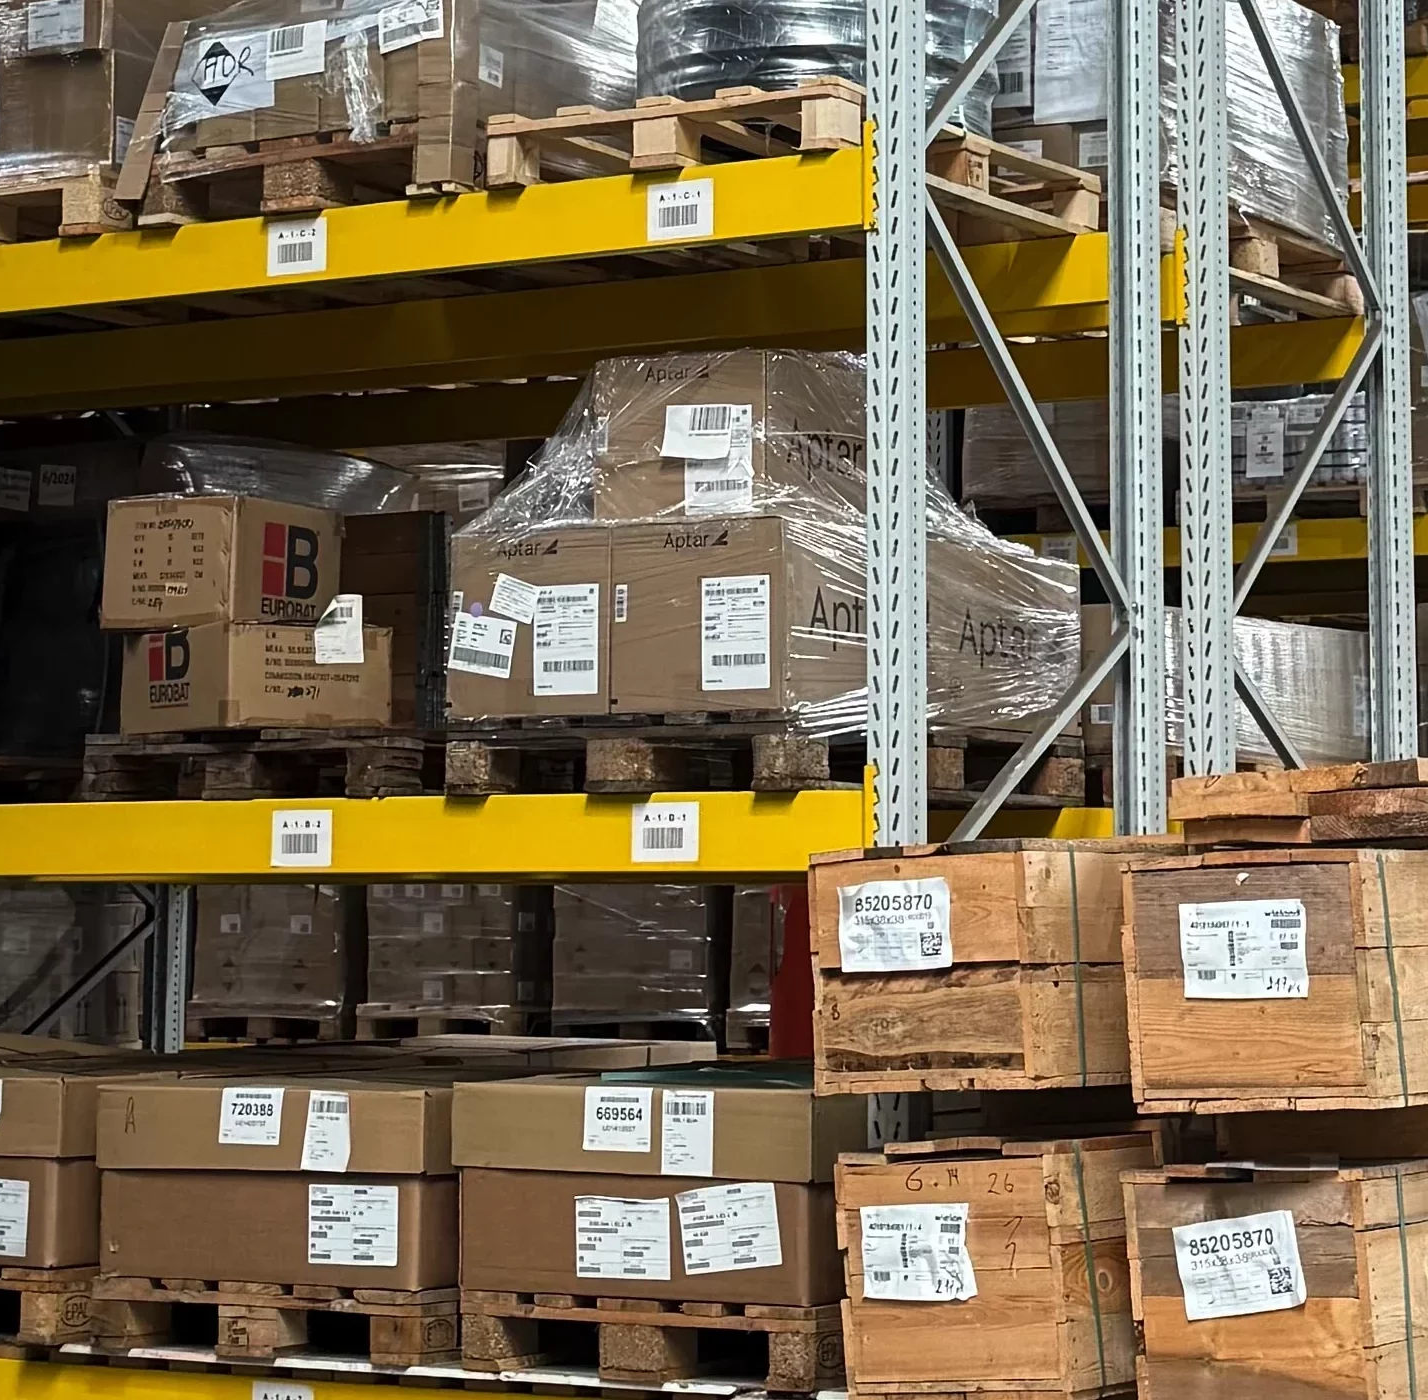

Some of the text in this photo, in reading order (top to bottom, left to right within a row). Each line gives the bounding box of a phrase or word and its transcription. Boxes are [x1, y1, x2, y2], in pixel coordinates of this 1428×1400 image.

[663, 531, 709, 551] Aptar
[261, 597, 316, 617] EUROBAT
[810, 586, 866, 650] Apt
[149, 682, 190, 703] EUROBAT
[231, 1103, 274, 1117] 720388
[596, 1106, 643, 1121] 669564
[1189, 1228, 1274, 1256] 85205870
